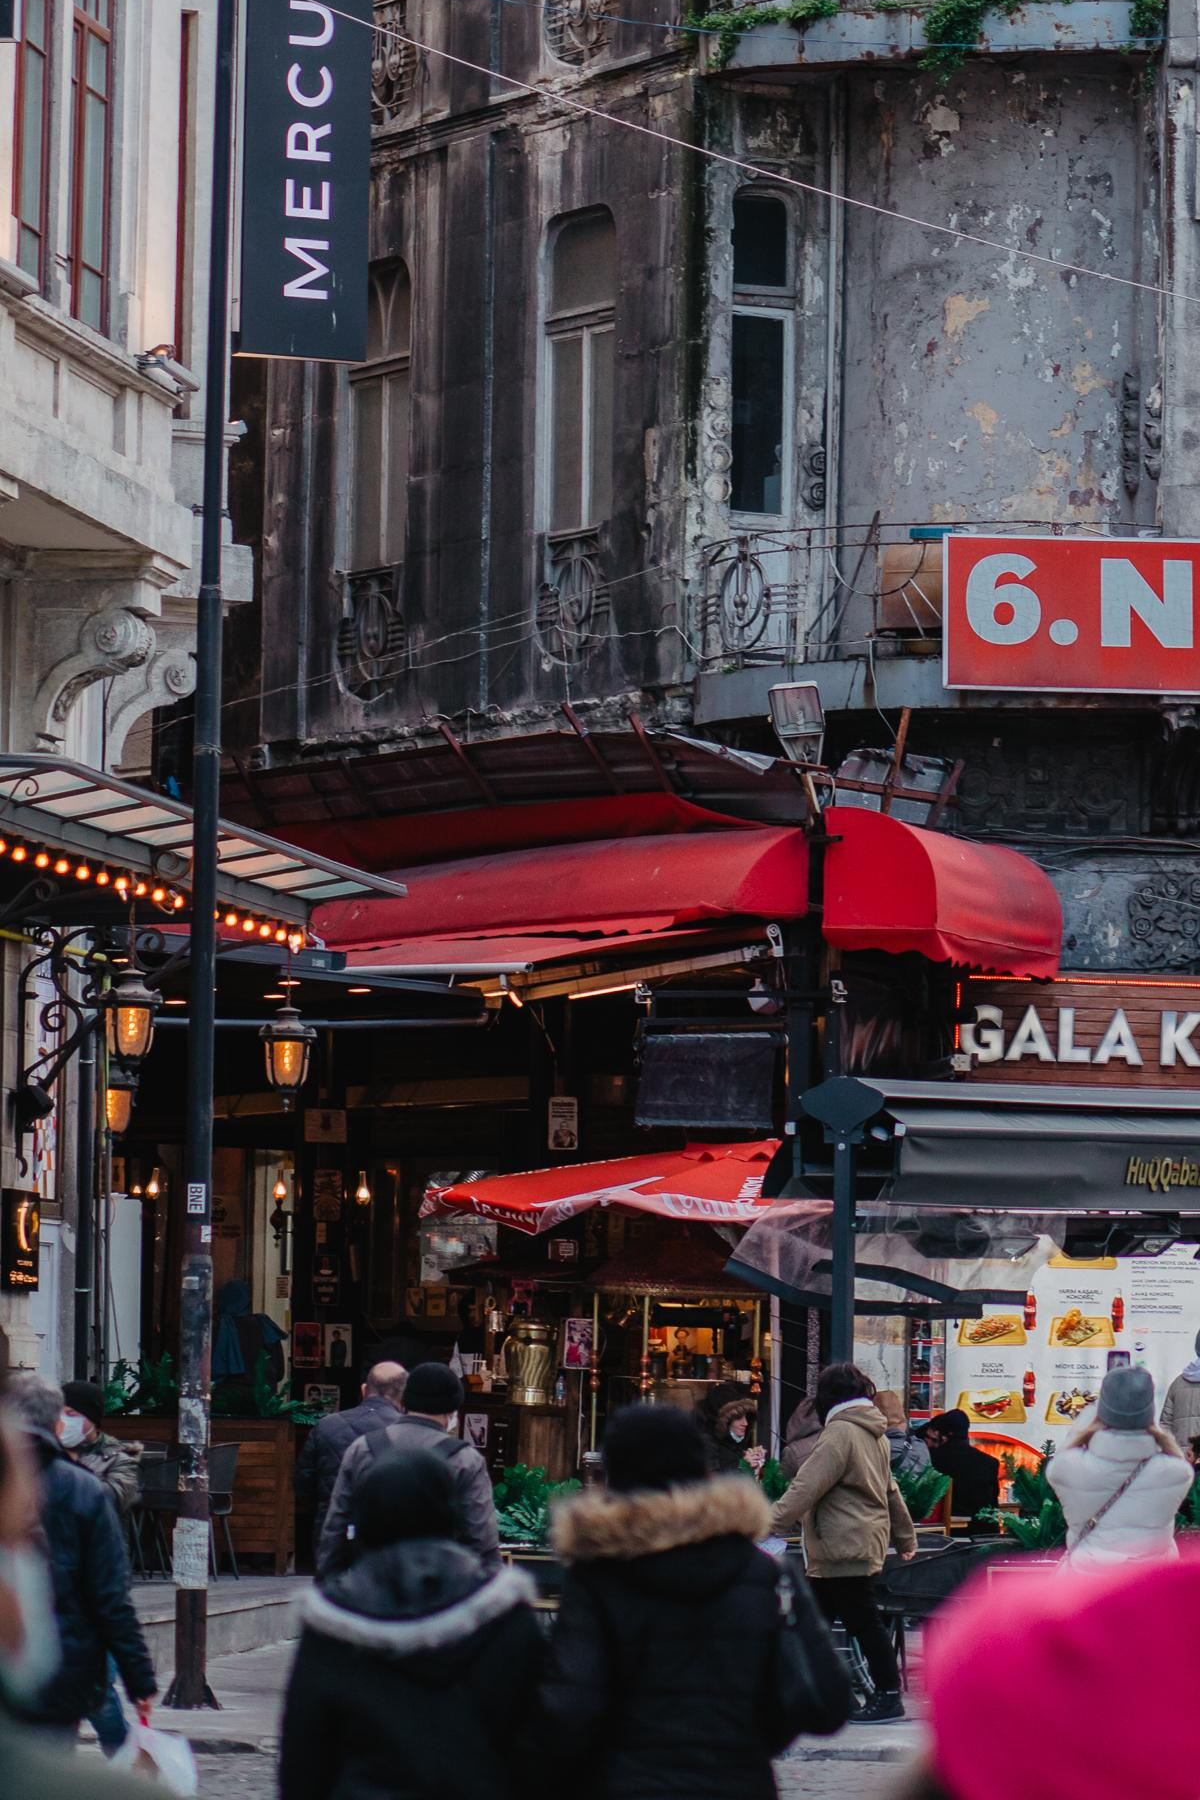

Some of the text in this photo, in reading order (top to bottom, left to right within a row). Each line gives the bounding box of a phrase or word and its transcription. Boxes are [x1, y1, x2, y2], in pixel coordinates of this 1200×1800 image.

[965, 552, 1080, 646] 6.
[960, 1004, 1144, 1067] GALA
[188, 1184, 206, 1213] BNE
